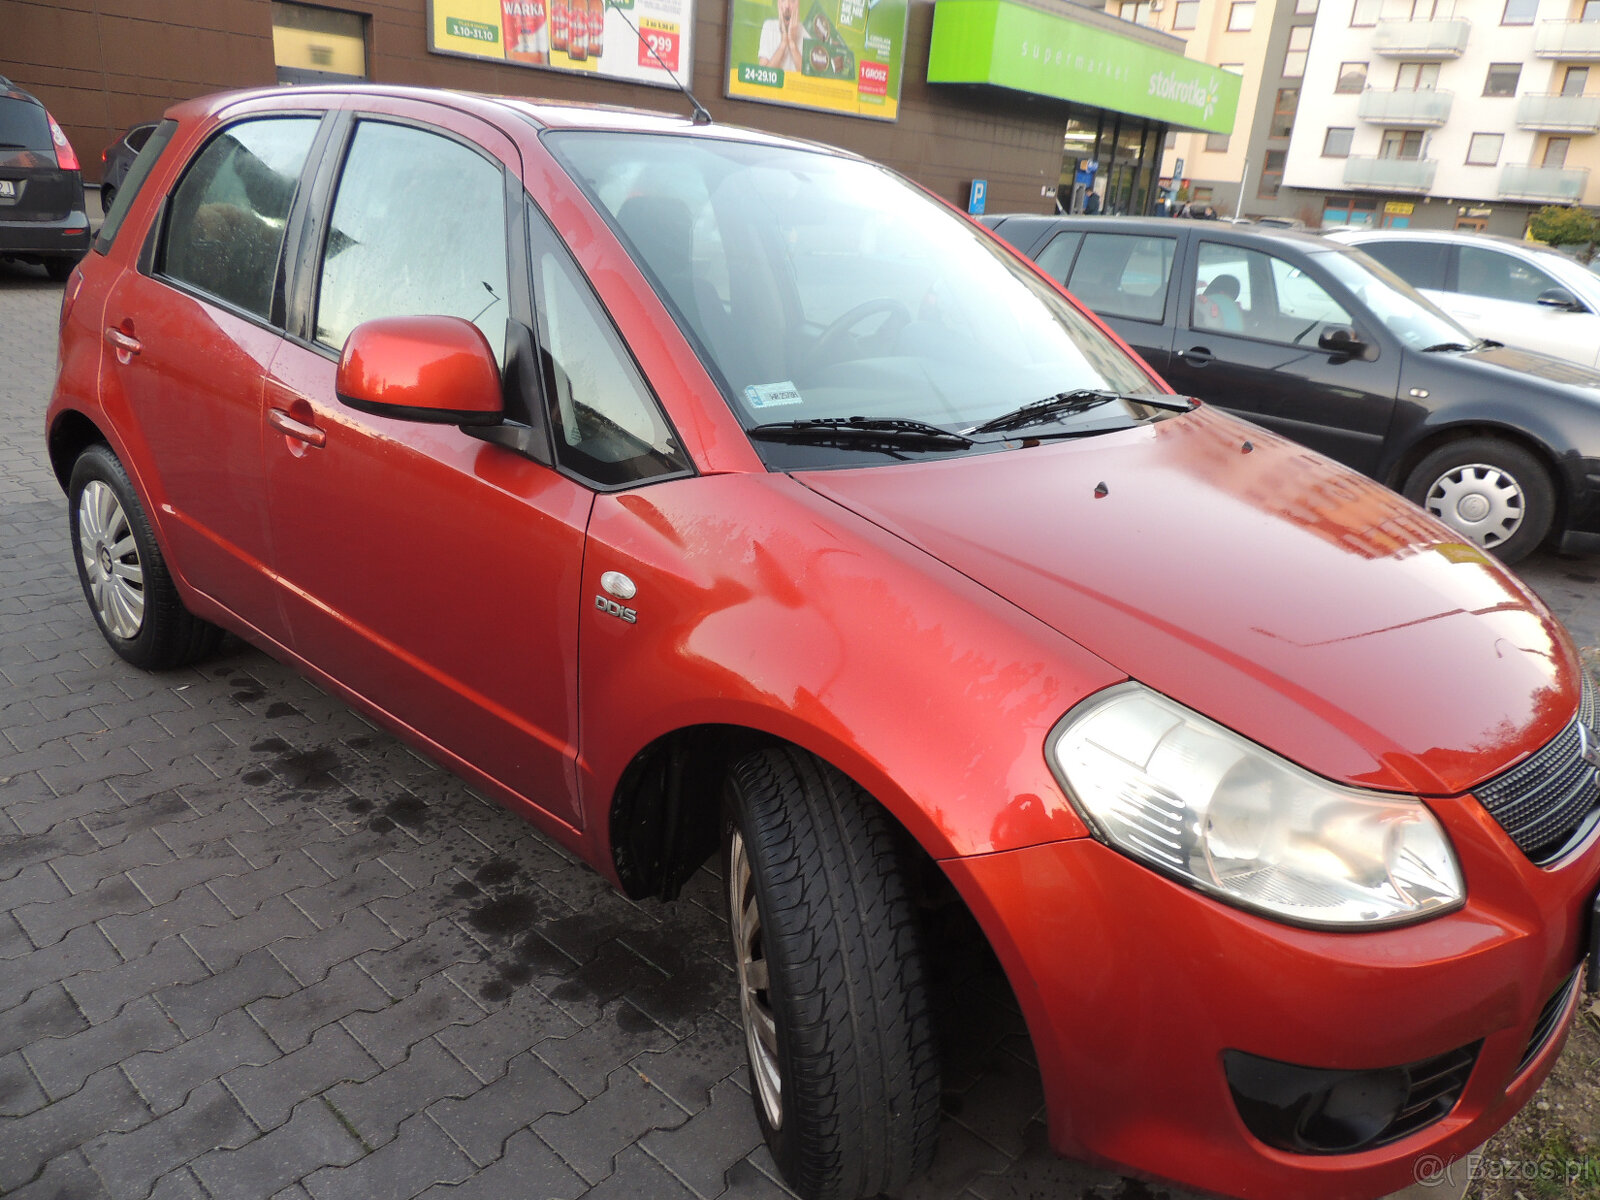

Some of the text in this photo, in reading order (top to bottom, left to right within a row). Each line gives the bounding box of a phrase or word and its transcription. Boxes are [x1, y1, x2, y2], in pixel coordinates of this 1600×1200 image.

[503, 2, 544, 16] WARKA
[453, 24, 494, 41] 3.10-31.10
[1021, 41, 1129, 83] supermarket
[744, 67, 778, 84] 24-29.10
[865, 68, 887, 82] GROSZ
[1148, 71, 1207, 108] stokrotka
[973, 183, 984, 204] P
[594, 594, 638, 624] DDiS
